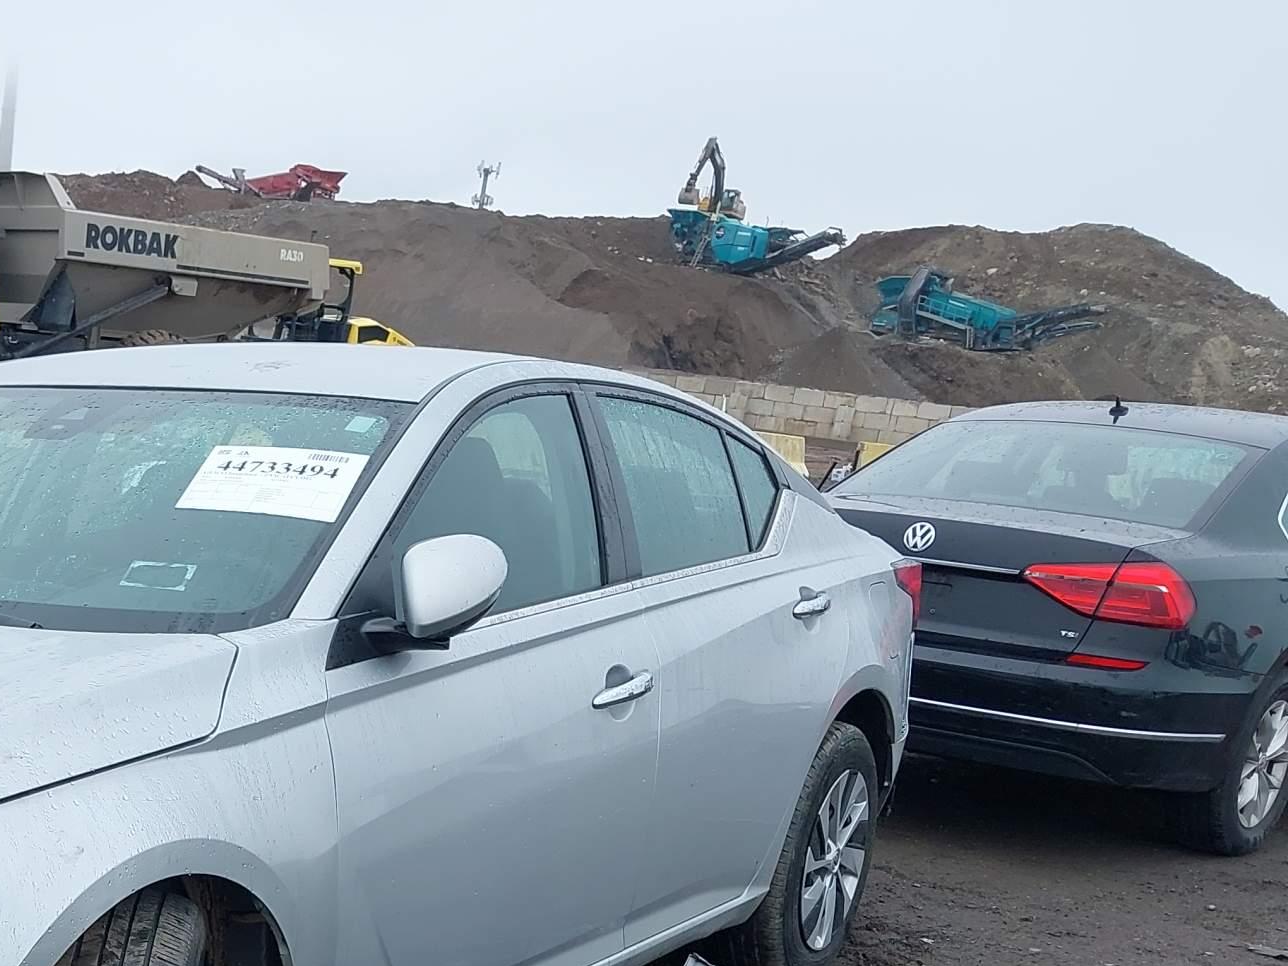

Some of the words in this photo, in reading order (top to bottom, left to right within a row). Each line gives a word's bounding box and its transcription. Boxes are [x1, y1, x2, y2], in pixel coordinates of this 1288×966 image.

[85, 223, 179, 259] ROKBAK
[279, 248, 304, 262] RA30
[217, 460, 339, 479] 44733494
